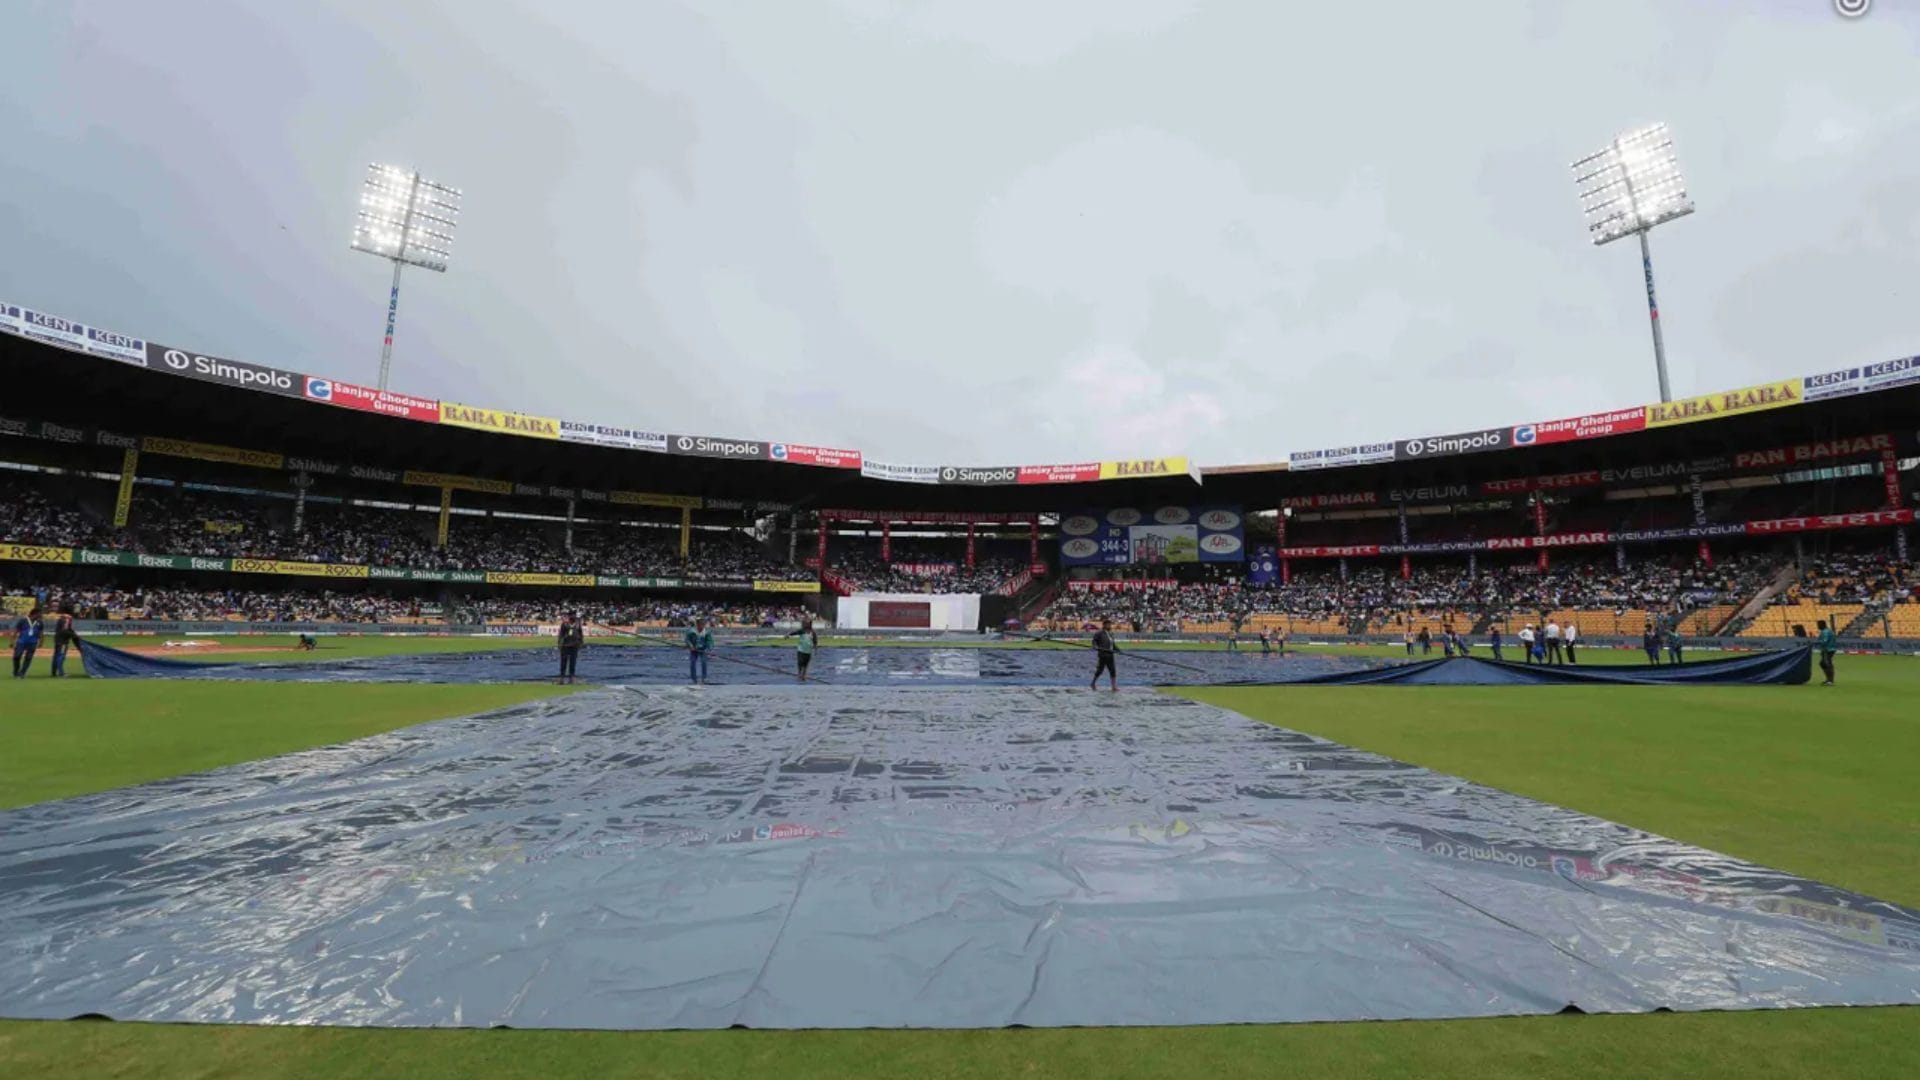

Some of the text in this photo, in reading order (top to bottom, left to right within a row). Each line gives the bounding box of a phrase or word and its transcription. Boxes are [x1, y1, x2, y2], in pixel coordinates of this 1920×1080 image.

[195, 356, 292, 389] Simpolo
[1872, 357, 1914, 375] KENT
[1811, 371, 1850, 387] KENT
[334, 383, 439, 411] Sanjay Ghodawat
[373, 401, 410, 416] Group
[1538, 408, 1645, 434] Sanjay Ghodawat
[1576, 422, 1613, 438] Group
[696, 438, 759, 456] Simpolo
[1426, 434, 1500, 454] Simpolo
[1735, 448, 1785, 468] PAN
[1794, 434, 1893, 459] BAHAR
[288, 457, 339, 474] Shikhar
[1602, 463, 1686, 482] EVEIUM
[959, 467, 1014, 483] Simpolo
[1048, 472, 1076, 481] Group
[1281, 491, 1376, 509] PAN BAHAR
[1390, 485, 1468, 502] EVEIUM
[1608, 530, 1660, 541] EVEIUM
[1689, 524, 1746, 536] EVEIUM
[1101, 539, 1129, 552] 344-3
[1487, 533, 1605, 549] PAN BAHAR
[10, 546, 67, 561] ROXX
[235, 560, 279, 573] ROXX
[325, 564, 364, 576] ROXX
[371, 567, 405, 578] Shikhar
[451, 571, 483, 581] Shikhar
[489, 573, 522, 583] ROXX
[560, 574, 592, 585] ROXX
